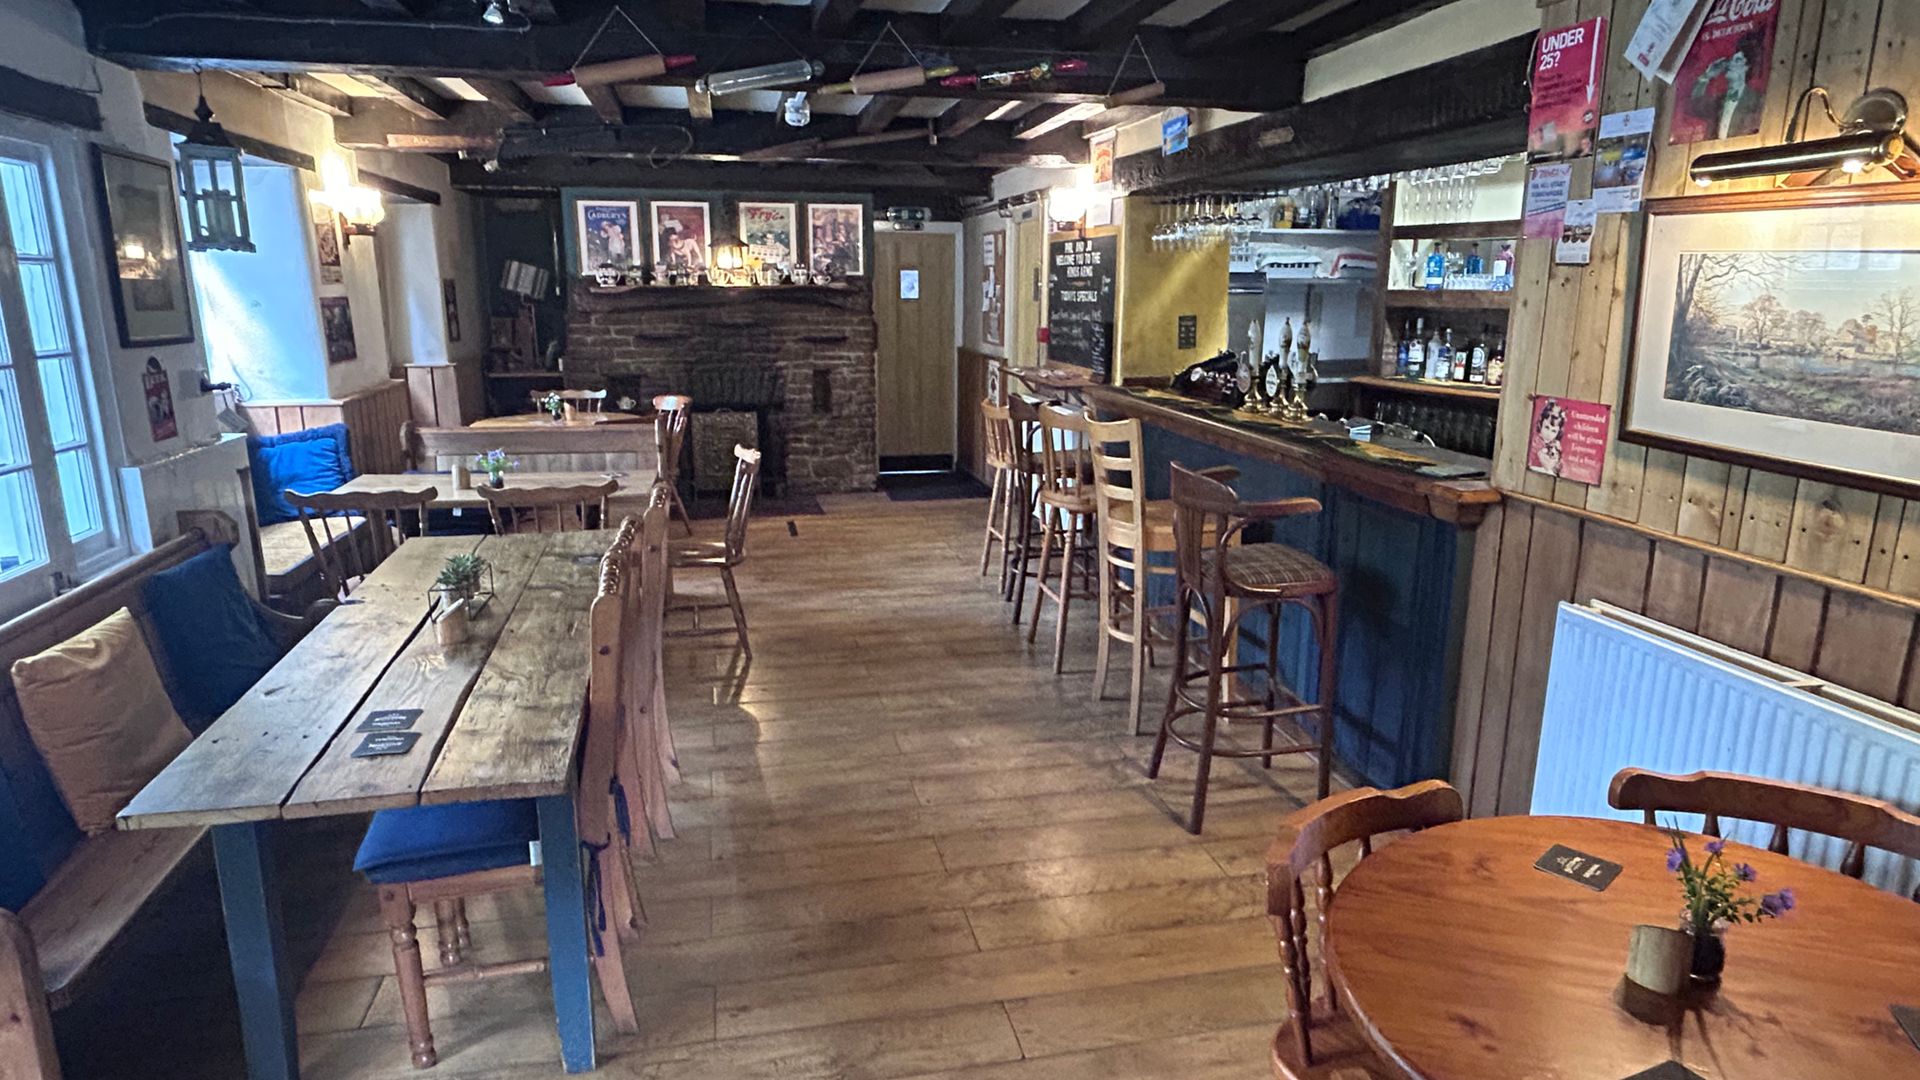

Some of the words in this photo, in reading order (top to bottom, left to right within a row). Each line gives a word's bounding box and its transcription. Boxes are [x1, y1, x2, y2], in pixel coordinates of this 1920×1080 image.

[1542, 28, 1584, 53] UNDER
[1539, 51, 1561, 71] 25?
[1056, 253, 1075, 266] WELCOME
[1091, 252, 1101, 264] THE
[1076, 290, 1098, 302] SPECIALS
